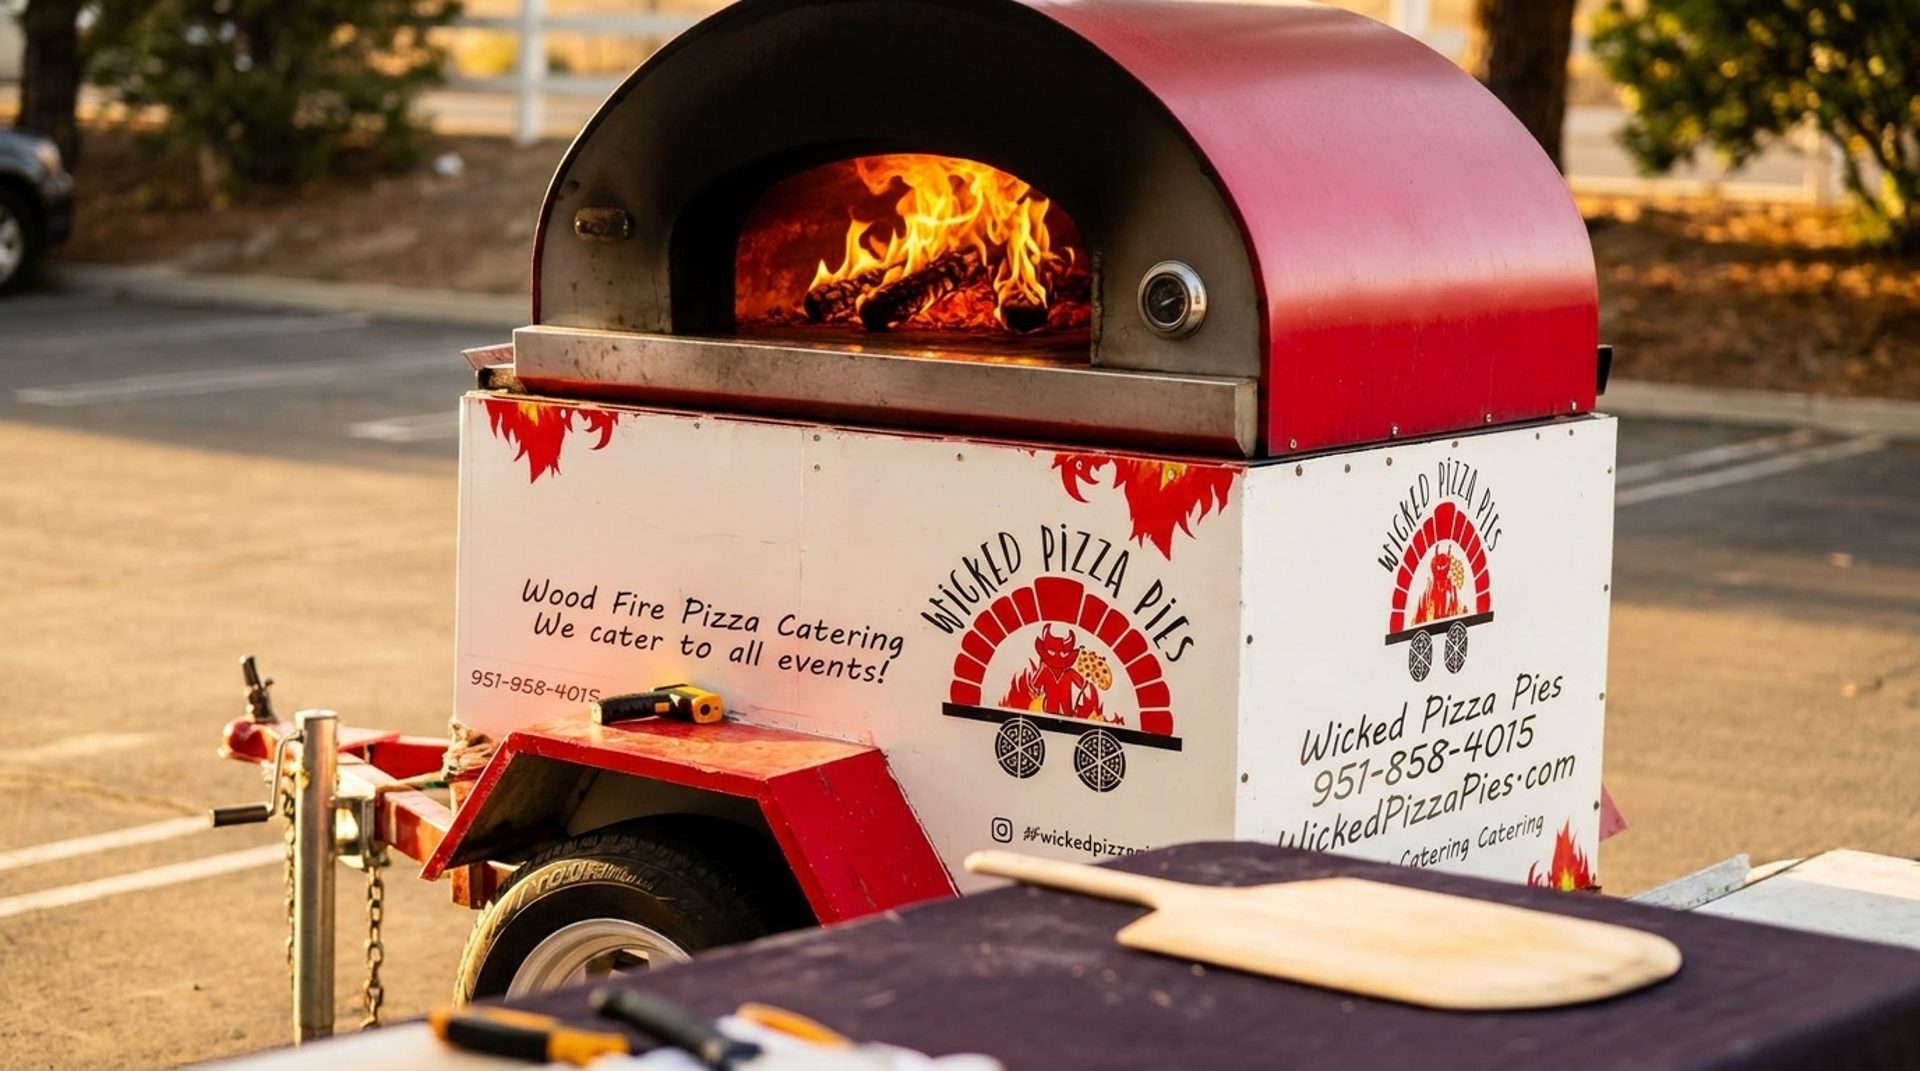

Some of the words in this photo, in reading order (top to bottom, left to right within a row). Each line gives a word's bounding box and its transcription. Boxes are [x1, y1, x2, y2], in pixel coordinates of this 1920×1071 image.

[522, 578, 598, 610] Wood
[612, 591, 664, 619] Fire
[682, 597, 760, 632] Pizza
[777, 614, 904, 660] Catering
[534, 612, 575, 638] We
[590, 625, 663, 651] cater
[680, 634, 712, 659] to
[729, 640, 764, 666] all
[778, 653, 890, 684] events!
[1300, 701, 1408, 766] Wicked
[1421, 692, 1497, 734] Pizza
[1511, 672, 1564, 710] Pies
[1312, 714, 1537, 808] 951-858-4015
[1477, 814, 1544, 848] Catering
